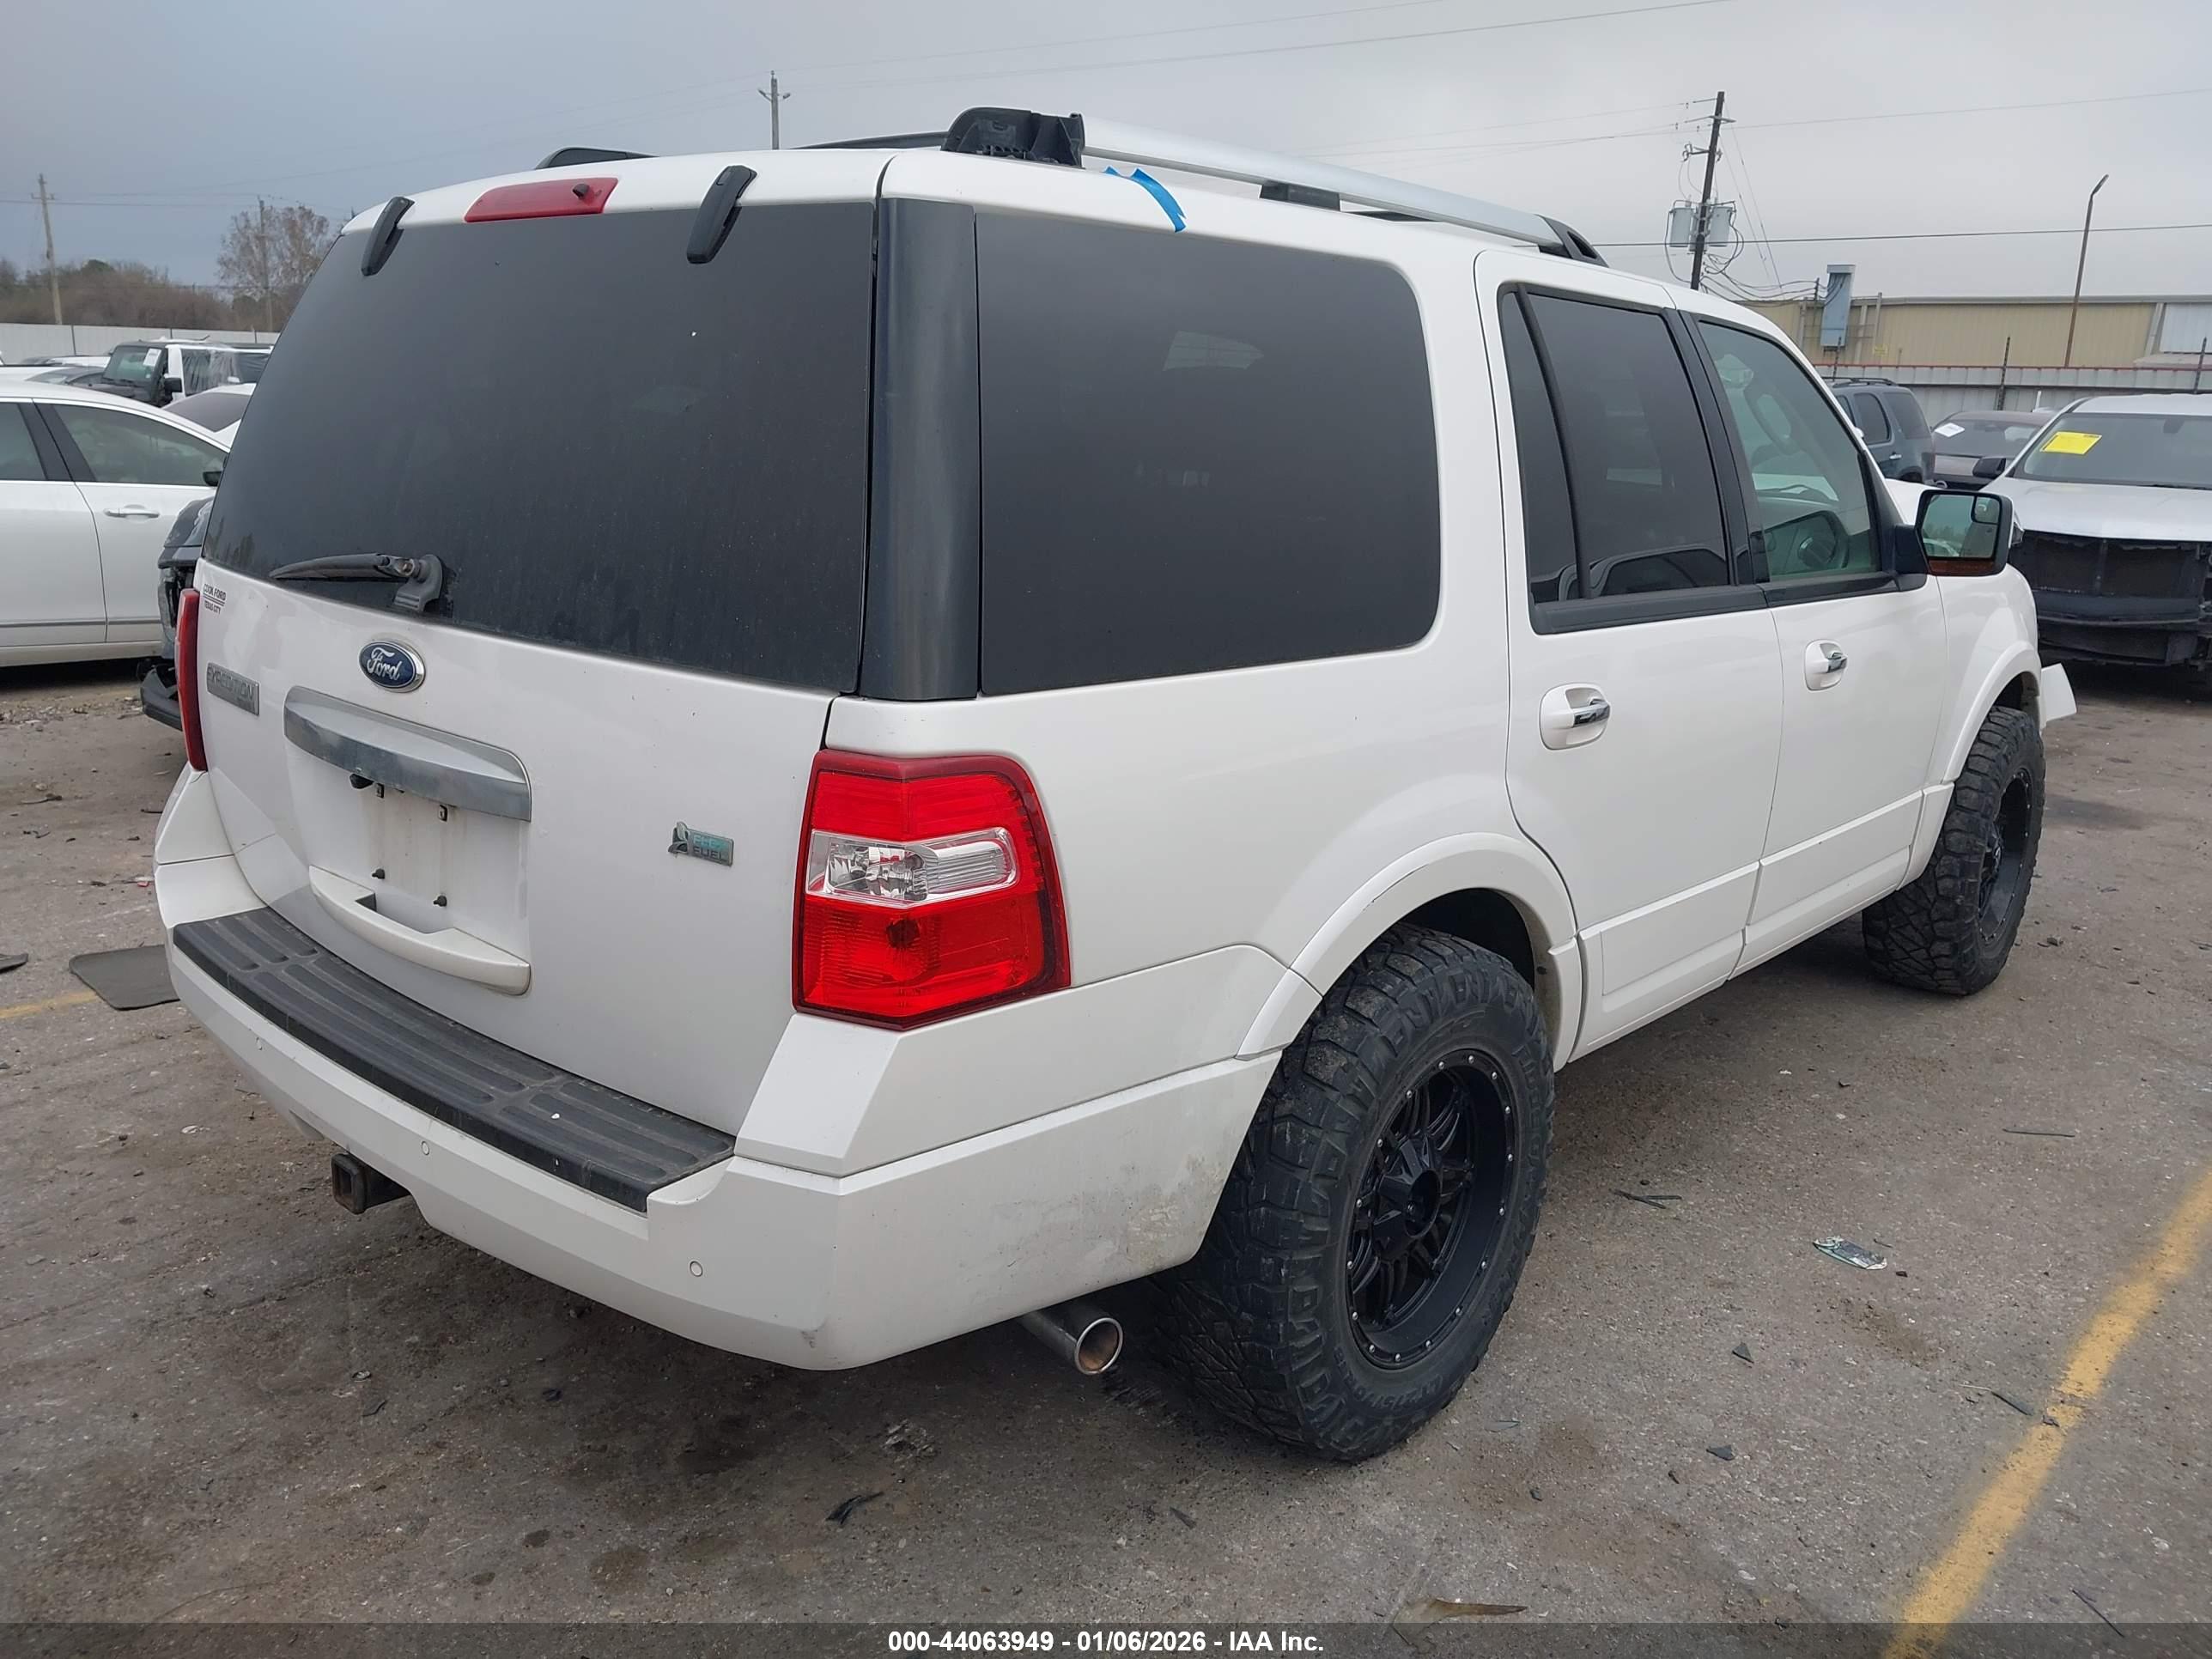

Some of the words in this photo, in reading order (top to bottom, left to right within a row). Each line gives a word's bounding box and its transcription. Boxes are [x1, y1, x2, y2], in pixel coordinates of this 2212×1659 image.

[214, 587, 227, 601] FORD
[213, 605, 222, 615] CITY
[366, 647, 403, 681] Ford
[207, 665, 254, 701] EXPEDITION
[693, 846, 726, 860] FUEL
